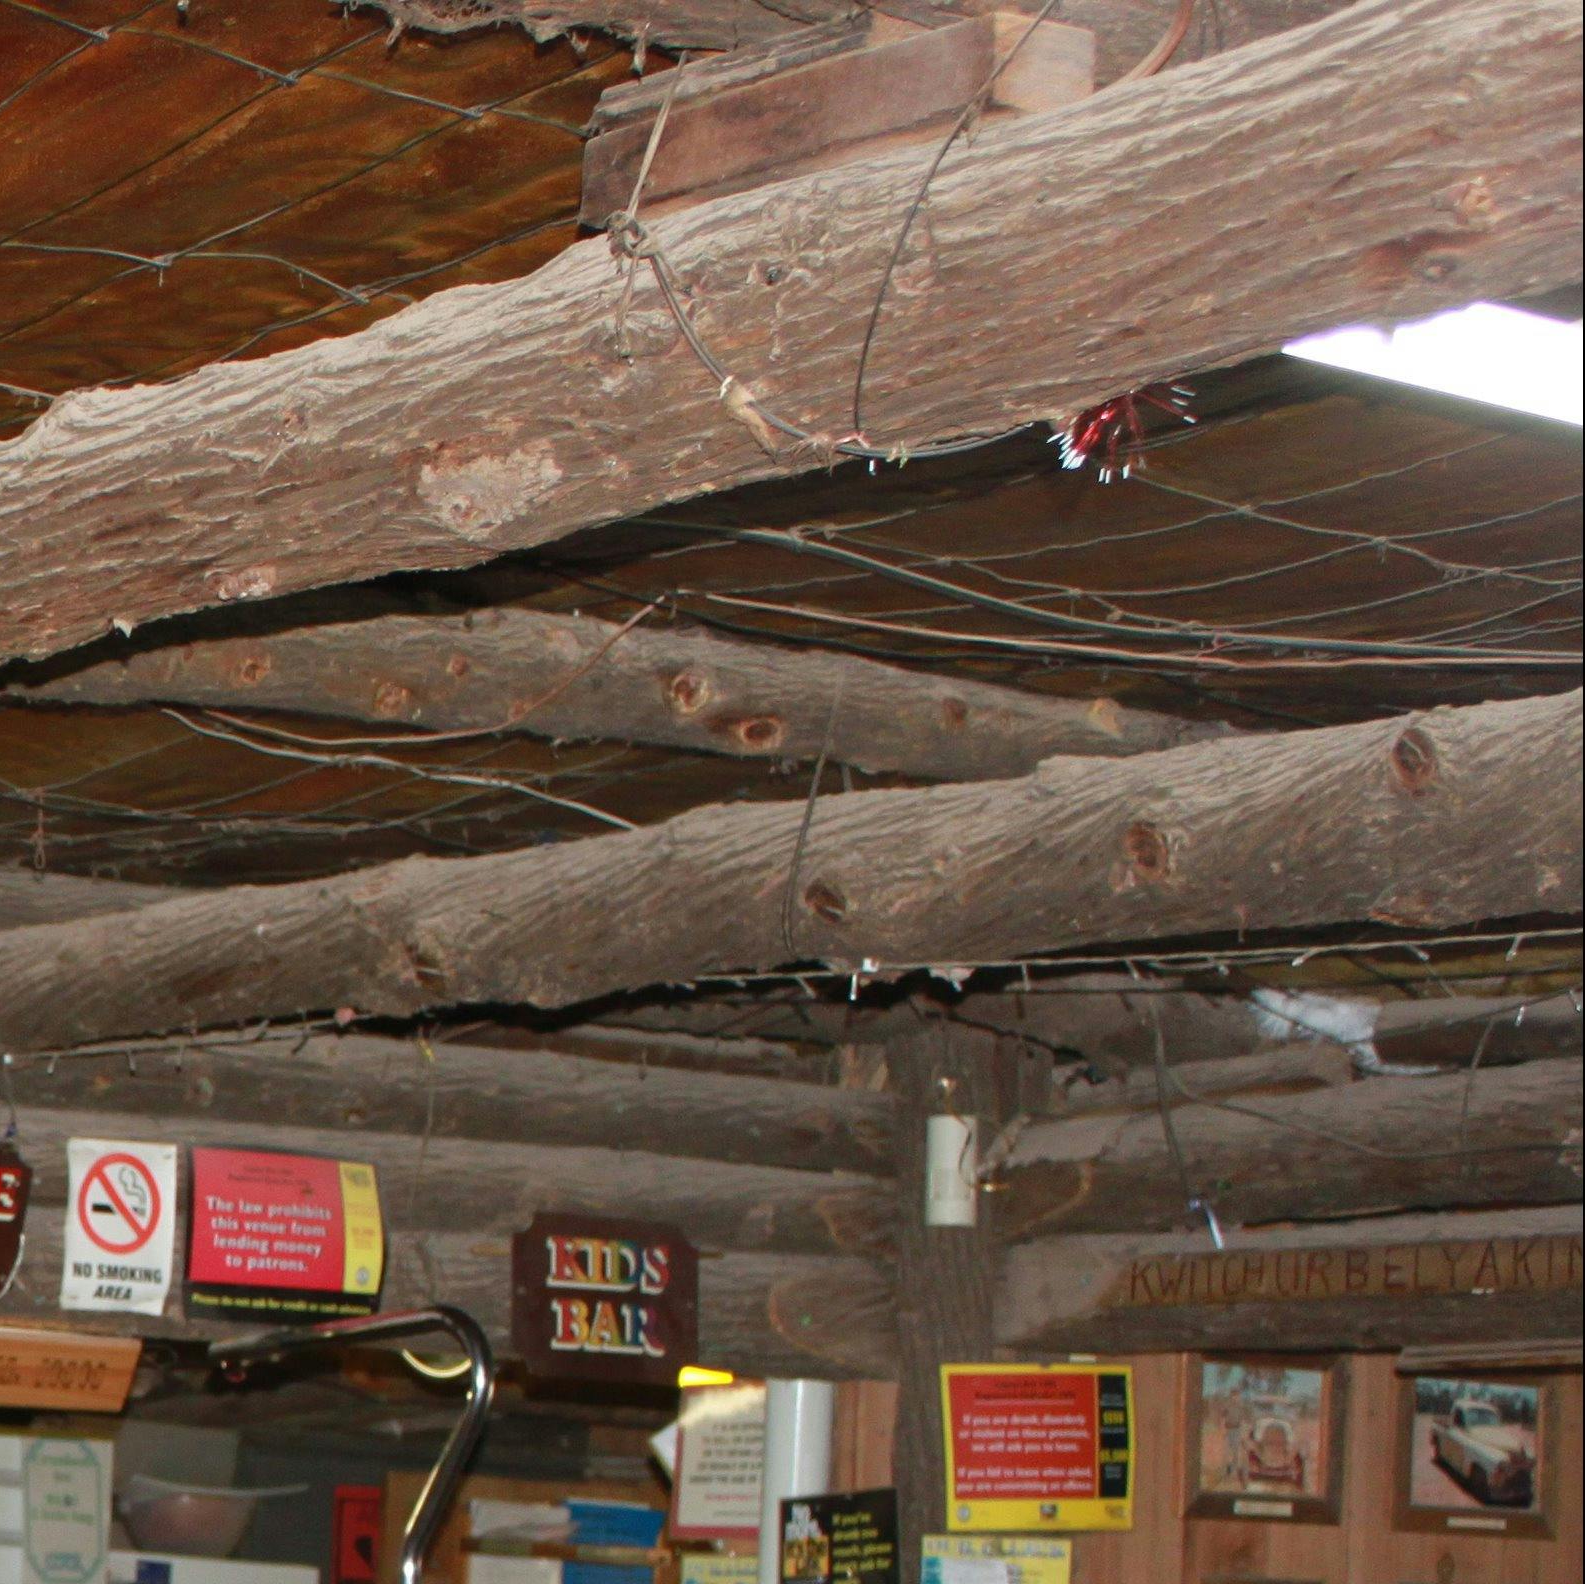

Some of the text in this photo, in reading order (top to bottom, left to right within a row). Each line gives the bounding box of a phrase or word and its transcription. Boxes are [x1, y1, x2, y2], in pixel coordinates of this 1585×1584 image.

[206, 1195, 332, 1220] The law prohibits
[211, 1216, 326, 1237] this venue from
[213, 1233, 321, 1258] lending money
[72, 1262, 162, 1284] NO SMOKING
[225, 1254, 309, 1273] to patrons.
[545, 1233, 671, 1295] KIDS
[93, 1282, 133, 1301] AREA
[550, 1297, 665, 1358] BAR
